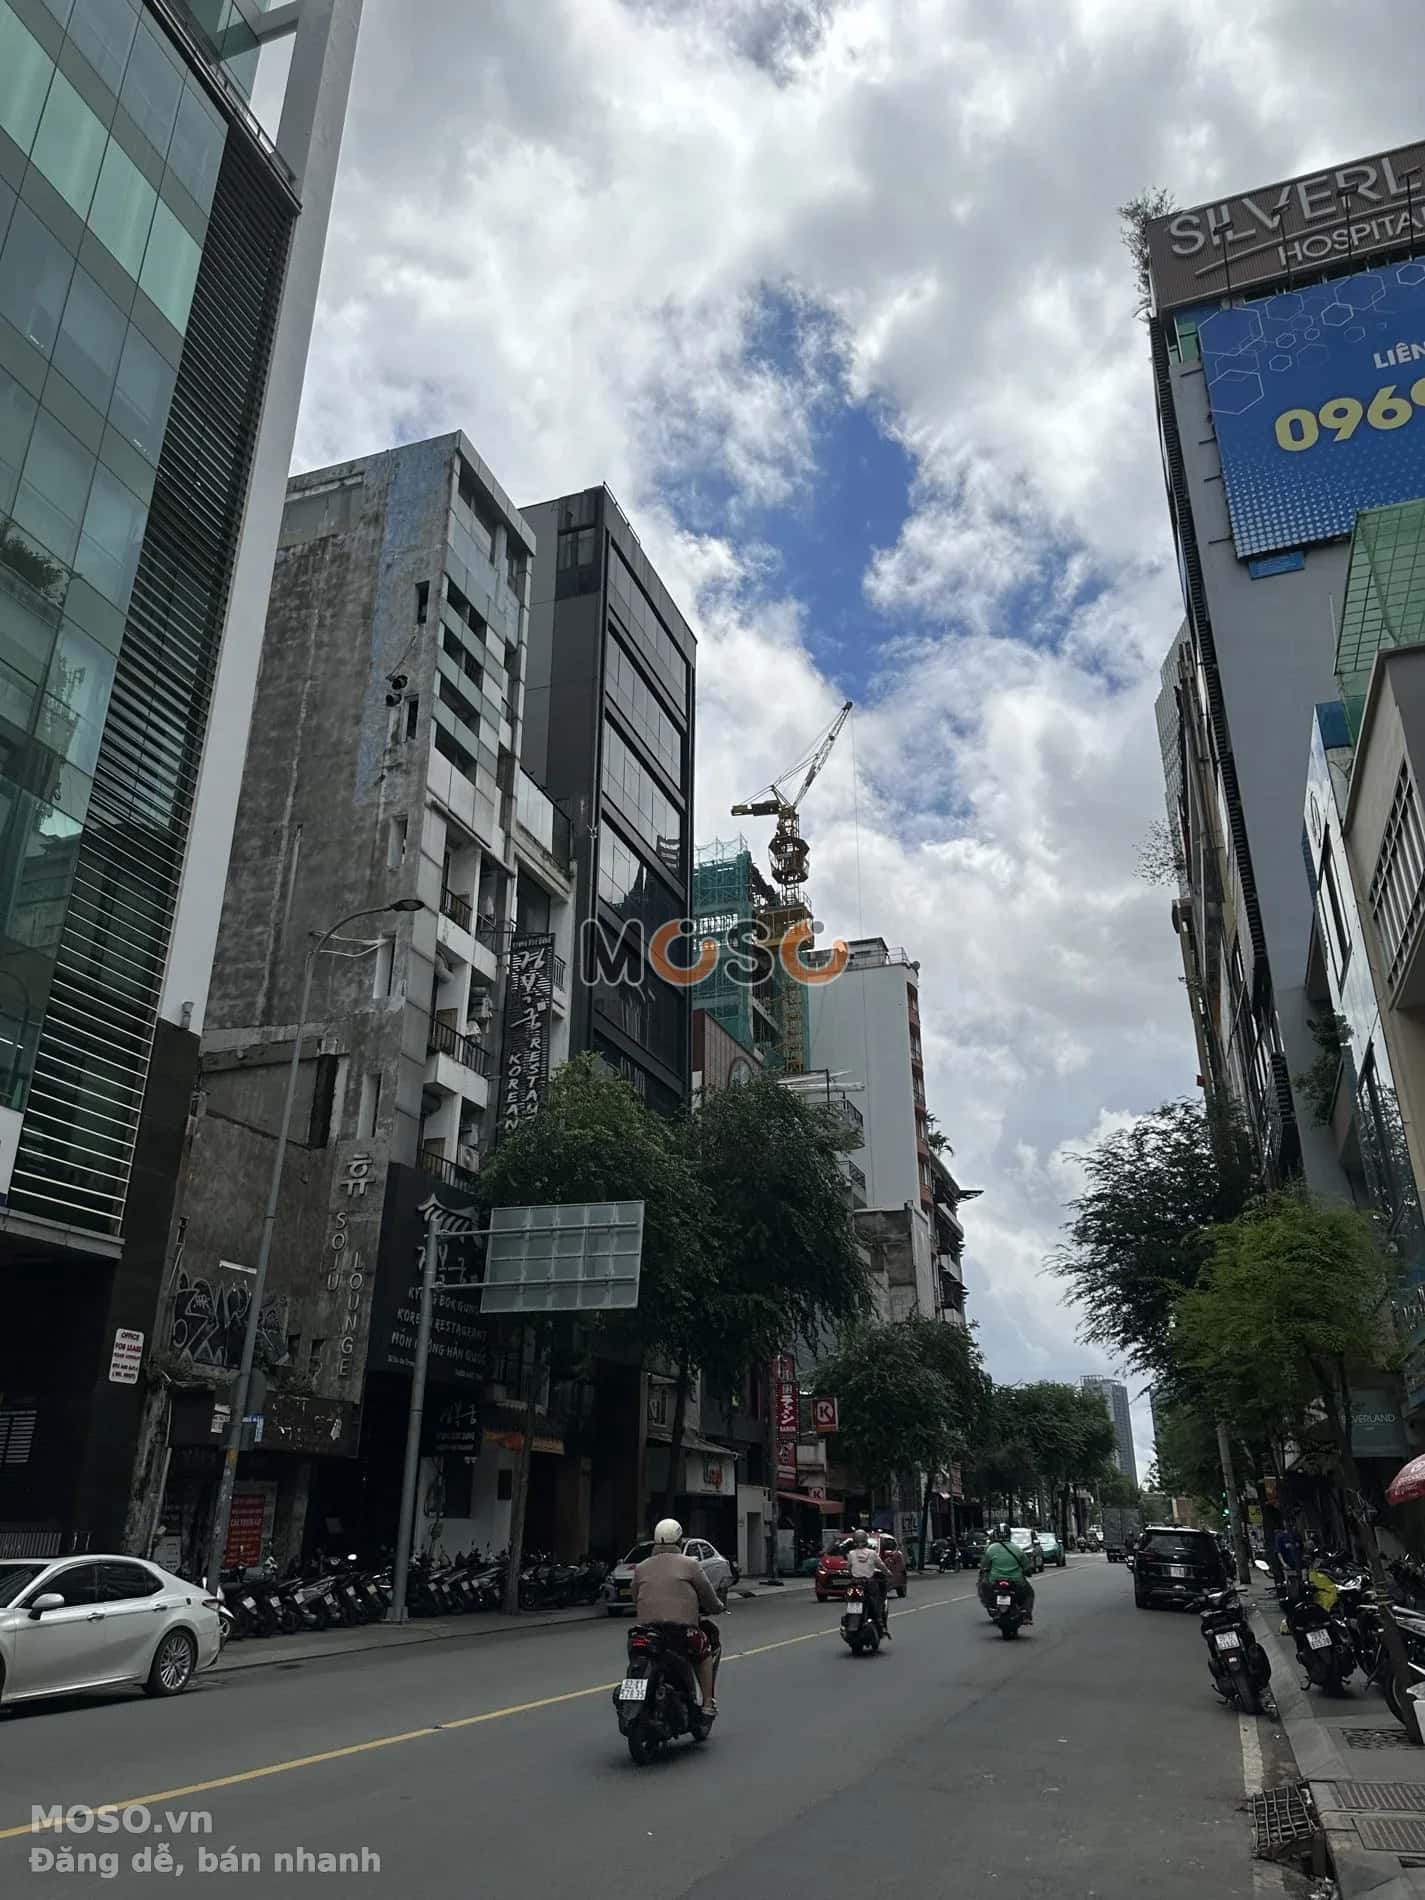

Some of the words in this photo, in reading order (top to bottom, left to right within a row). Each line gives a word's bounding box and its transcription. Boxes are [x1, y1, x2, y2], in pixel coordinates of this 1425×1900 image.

[1278, 206, 1425, 266] HOSPITA
[504, 1053, 522, 1130] KOREAN
[339, 1153, 377, 1197] 휴
[327, 1211, 347, 1291] SOJU
[339, 1251, 364, 1376] LOUNGE
